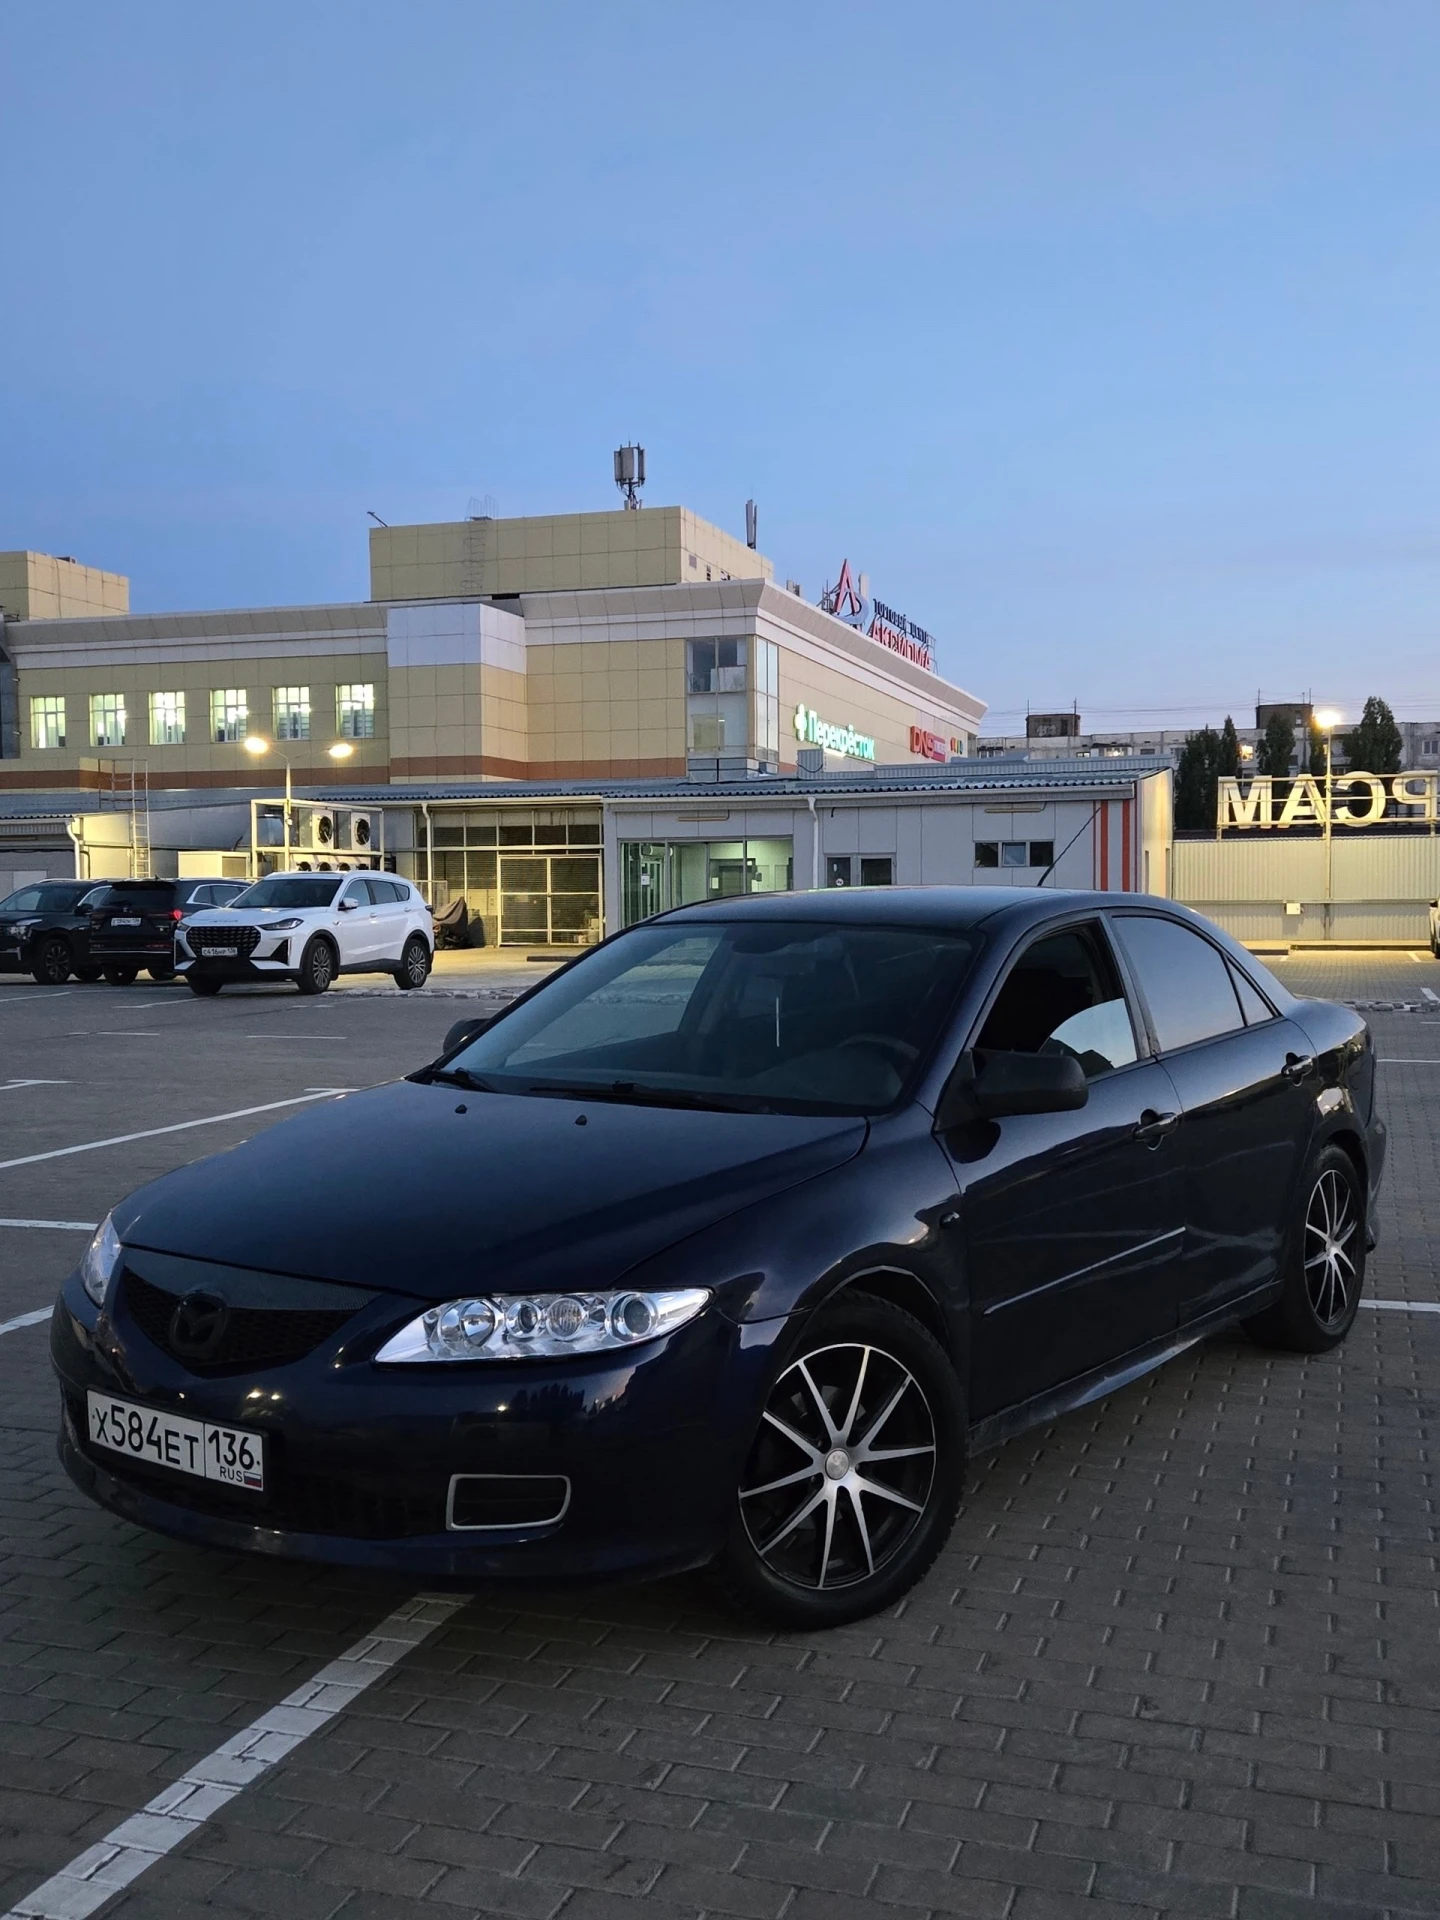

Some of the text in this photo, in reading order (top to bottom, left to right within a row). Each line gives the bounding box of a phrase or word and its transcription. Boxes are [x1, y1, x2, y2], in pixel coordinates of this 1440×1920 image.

[910, 725, 934, 758] DNS
[208, 1430, 254, 1470] 136
[219, 1466, 243, 1482] RUS
